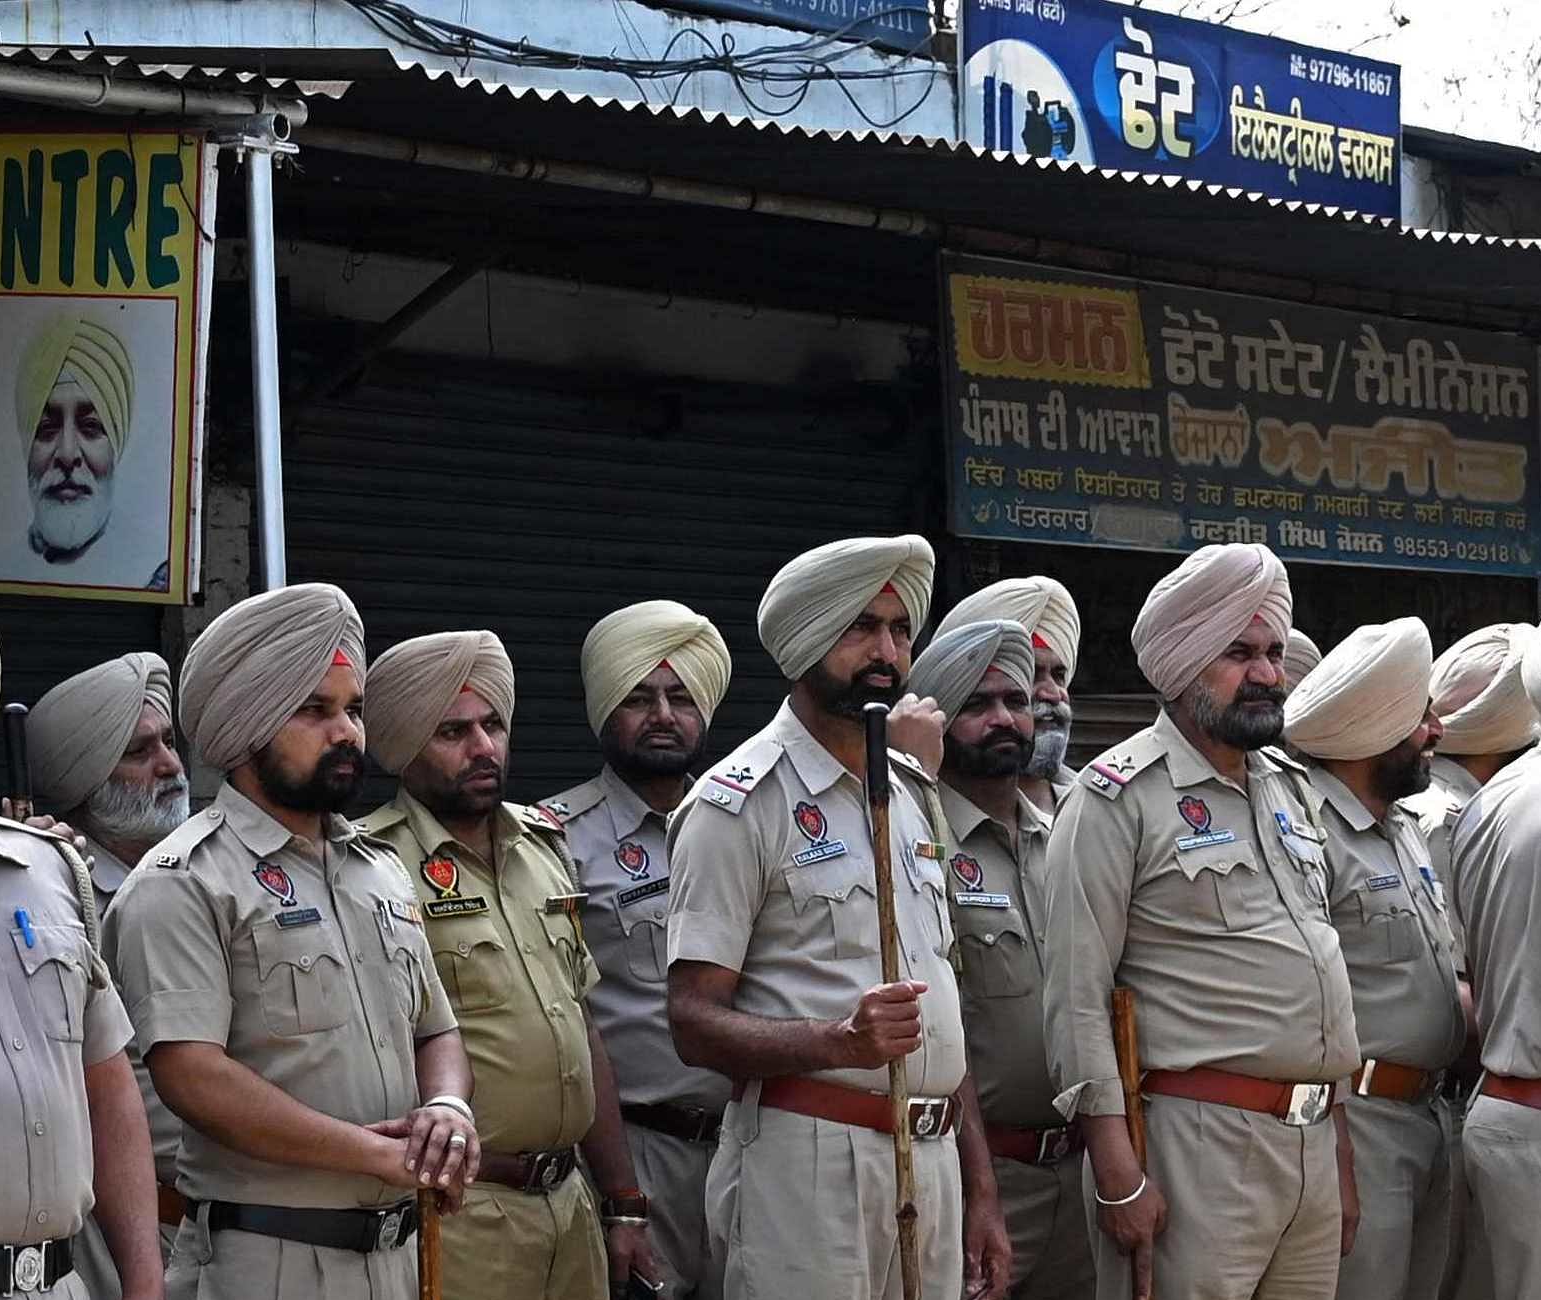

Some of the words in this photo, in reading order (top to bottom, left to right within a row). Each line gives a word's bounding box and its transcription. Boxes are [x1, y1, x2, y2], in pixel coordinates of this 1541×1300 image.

[1309, 56, 1392, 96] 97796-11867
[1338, 127, 1395, 187] ਵਰਕਸ
[967, 286, 1131, 374] ਹਰਮਨ
[1161, 304, 1225, 389] ਫੋਟੋ
[1231, 318, 1323, 399] ਸਟੇਟ
[959, 383, 1032, 450] ਪੰਜਾਬ
[1037, 389, 1069, 451] ਦੀ
[1277, 519, 1327, 549] ਸਿੰਘ
[1394, 535, 1509, 564] 98553-02918
